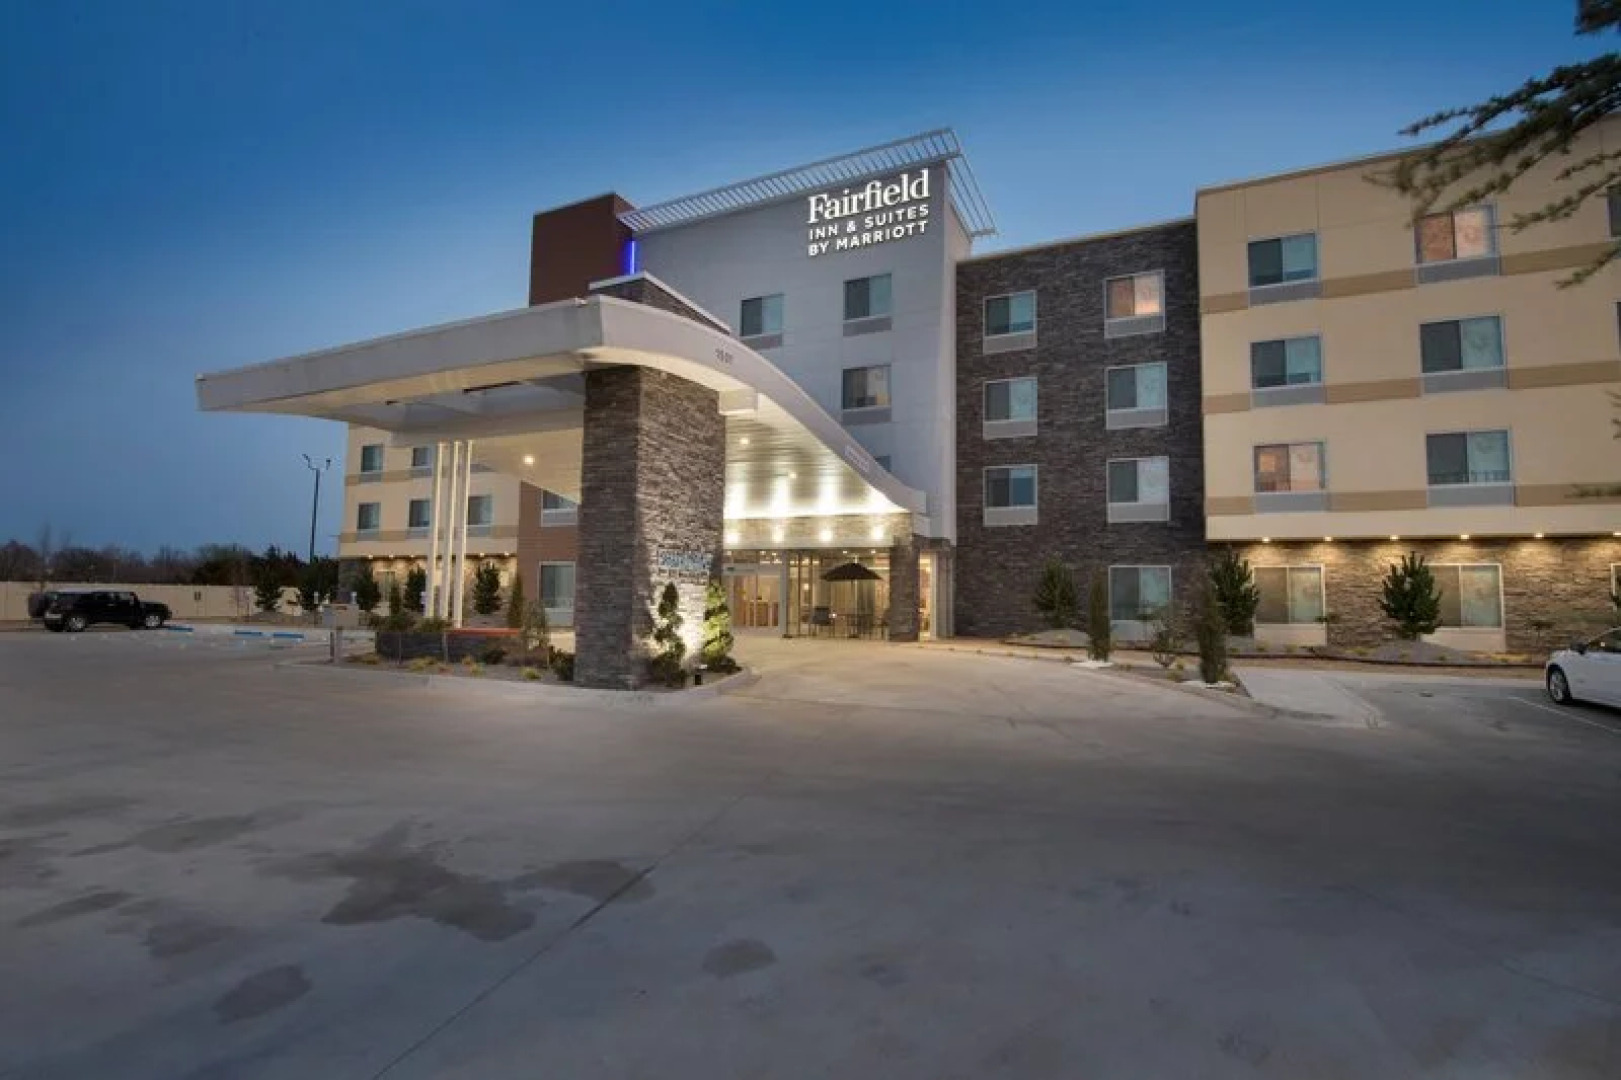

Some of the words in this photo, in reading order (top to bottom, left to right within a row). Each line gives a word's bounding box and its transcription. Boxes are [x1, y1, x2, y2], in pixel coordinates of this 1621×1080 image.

[807, 168, 930, 223] Fairfield
[808, 241, 829, 256] BY
[836, 220, 928, 250] MARRIOTT
[809, 223, 838, 239] INN
[846, 220, 856, 233] &
[864, 204, 929, 229] SUITES
